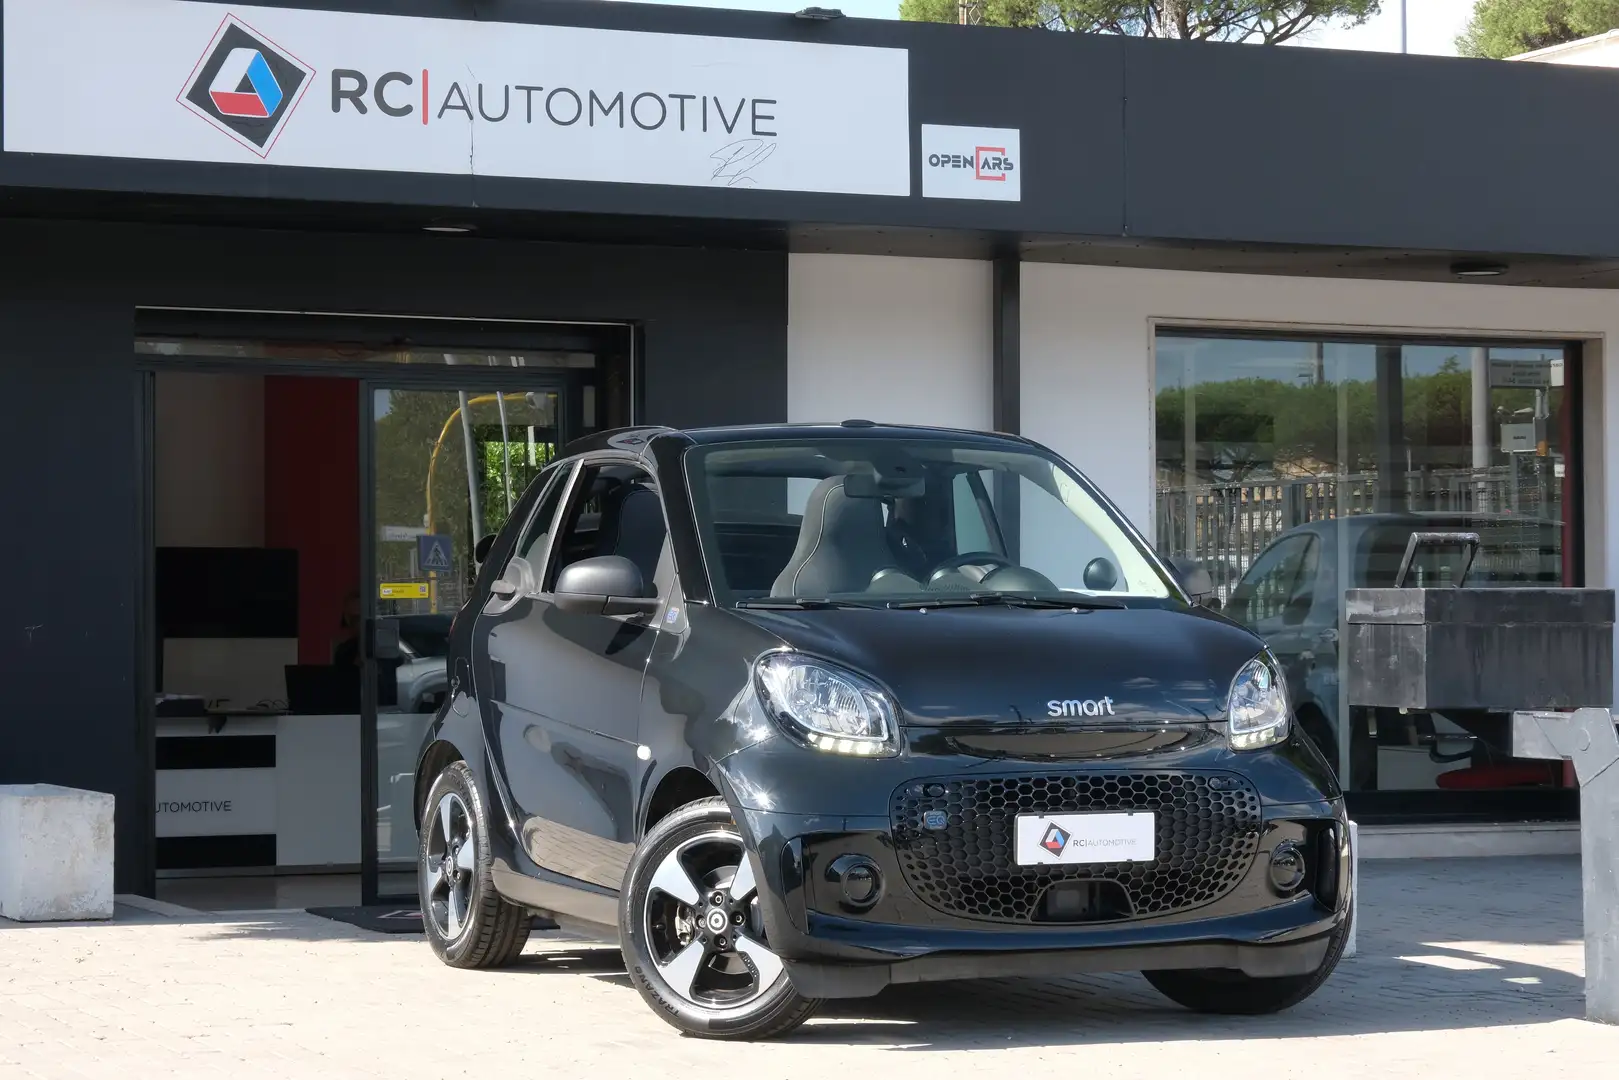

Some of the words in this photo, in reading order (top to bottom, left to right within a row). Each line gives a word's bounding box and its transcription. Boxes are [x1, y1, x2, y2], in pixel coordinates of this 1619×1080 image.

[437, 81, 778, 137] AUTOMOTIVE
[1047, 695, 1116, 717] smart
[1087, 838, 1137, 847] AUTOMOTIVE
[634, 965, 680, 1018] TRAZANO
